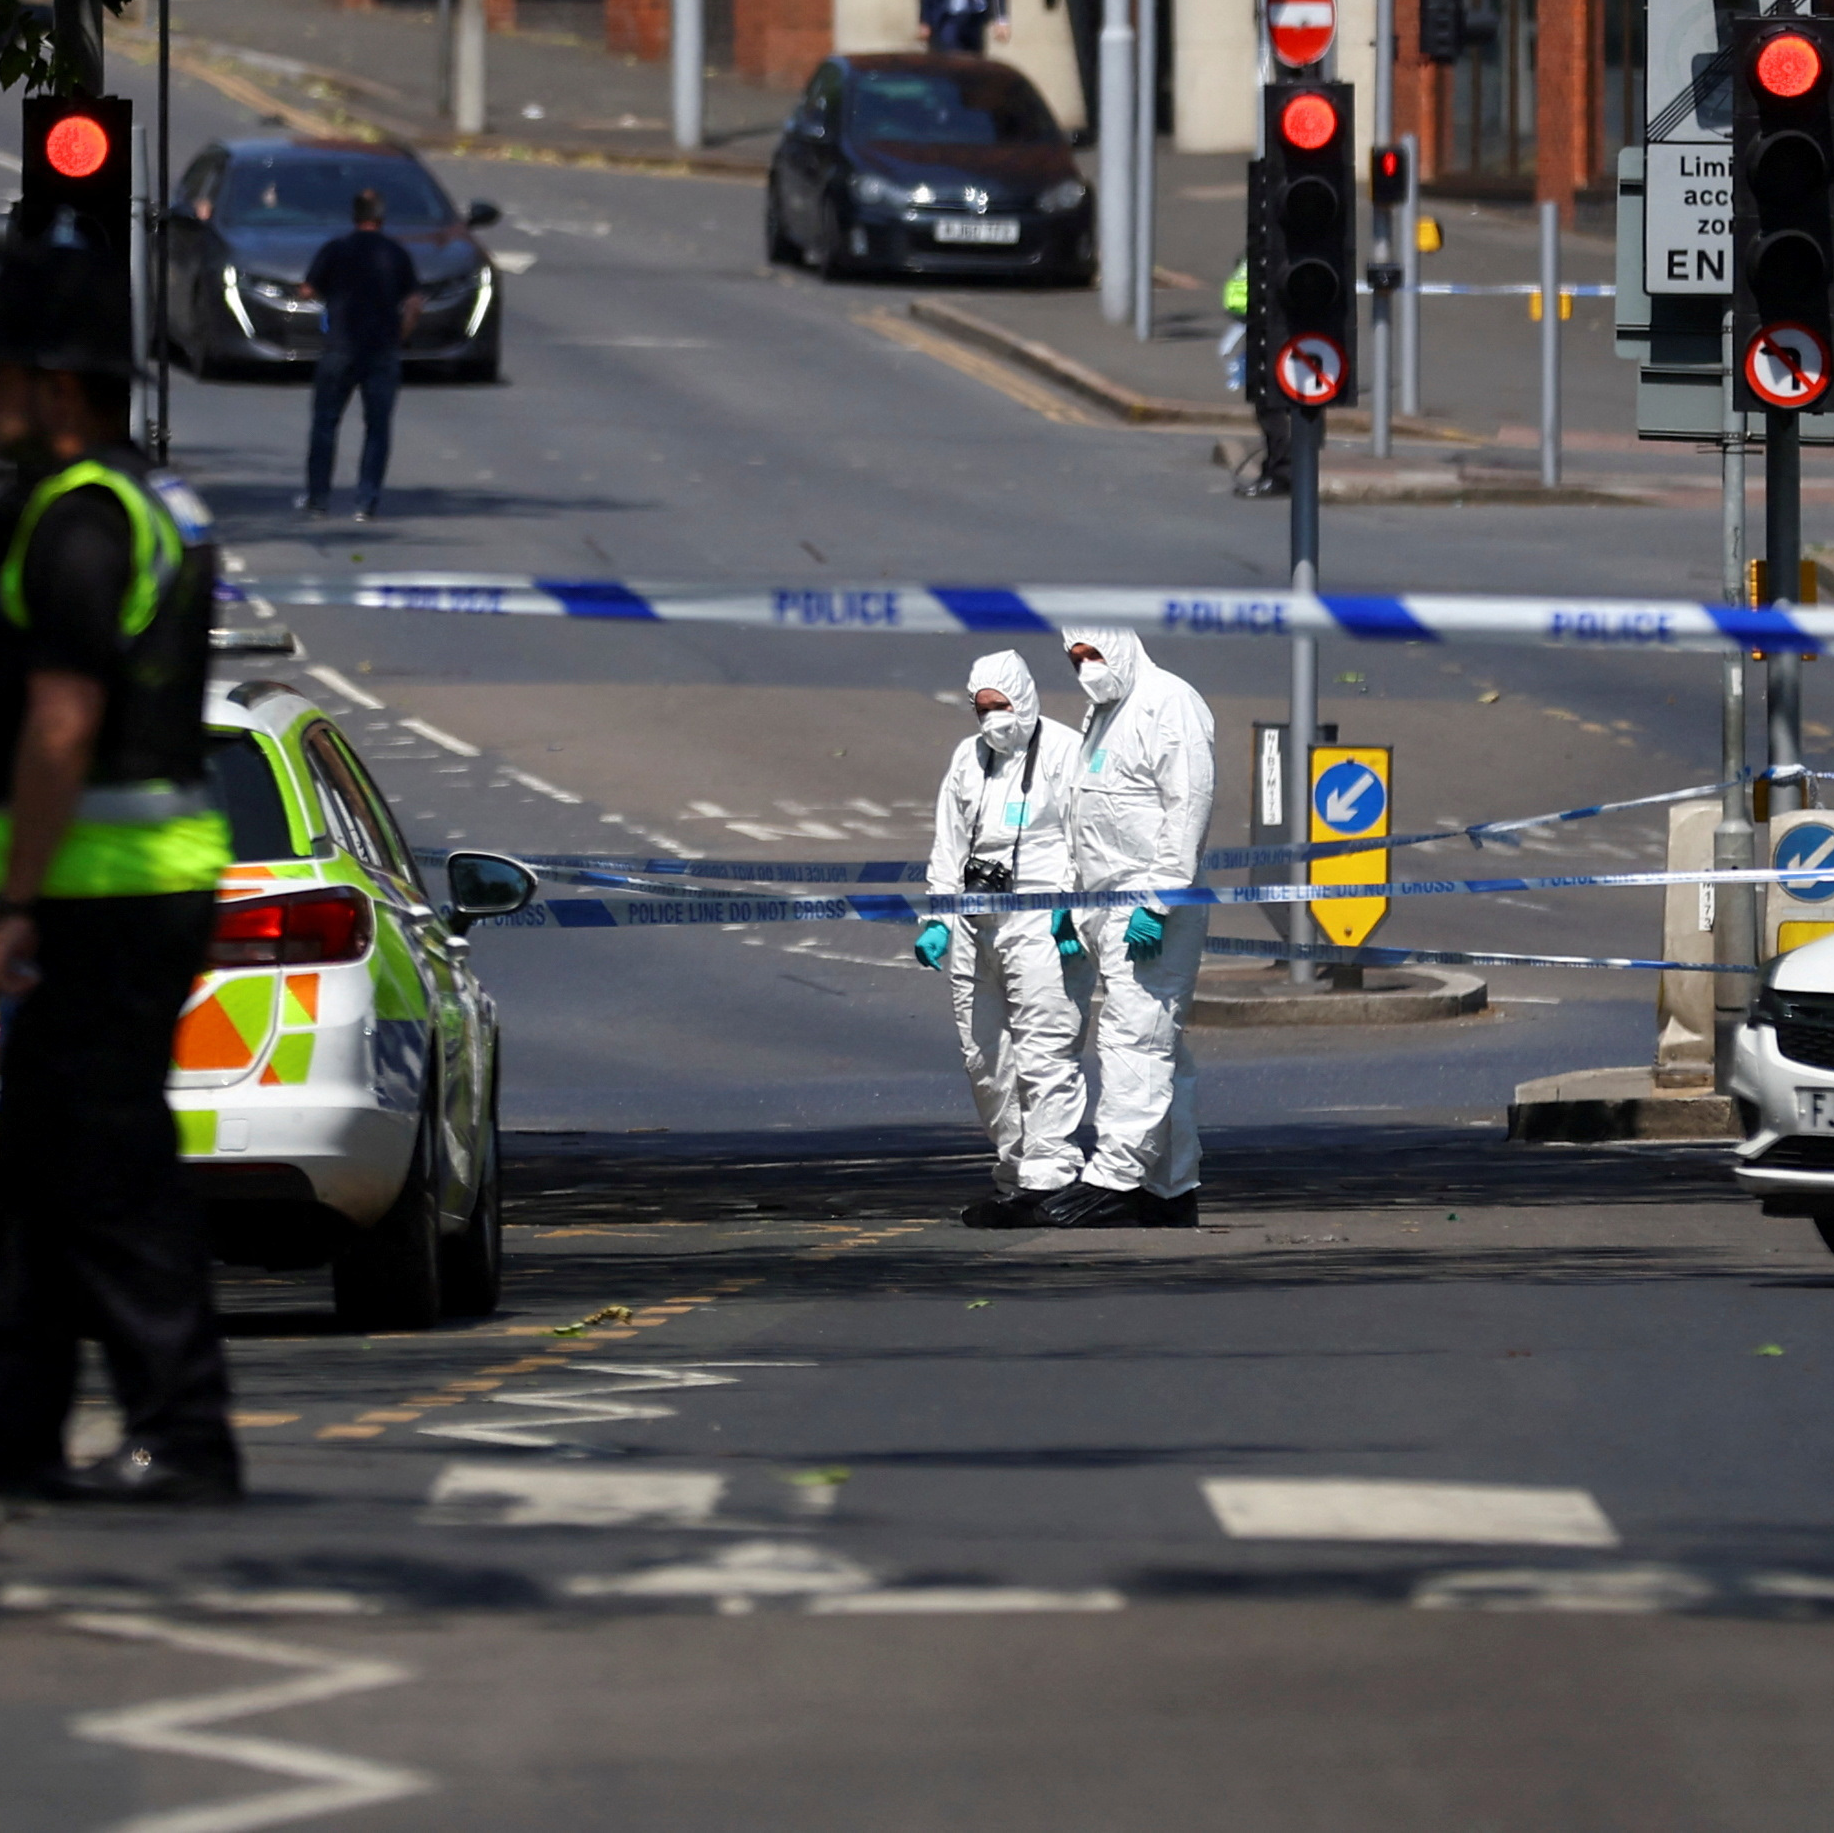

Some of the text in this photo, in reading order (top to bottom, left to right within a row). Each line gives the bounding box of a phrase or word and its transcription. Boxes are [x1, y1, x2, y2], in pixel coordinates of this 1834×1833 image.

[1680, 156, 1735, 178] Limi
[1684, 189, 1734, 207] acc
[1667, 250, 1725, 281] EN
[772, 588, 903, 625] POLICE
[1166, 600, 1292, 636] POLICE
[1552, 609, 1677, 642] POLICE
[929, 889, 1150, 914] POLICE LINE DO NOT CROSS
[1233, 880, 1456, 902] POLICE LINE DO NOT CROSS
[628, 899, 846, 924] POLICE LINE DO NOT CROSS
